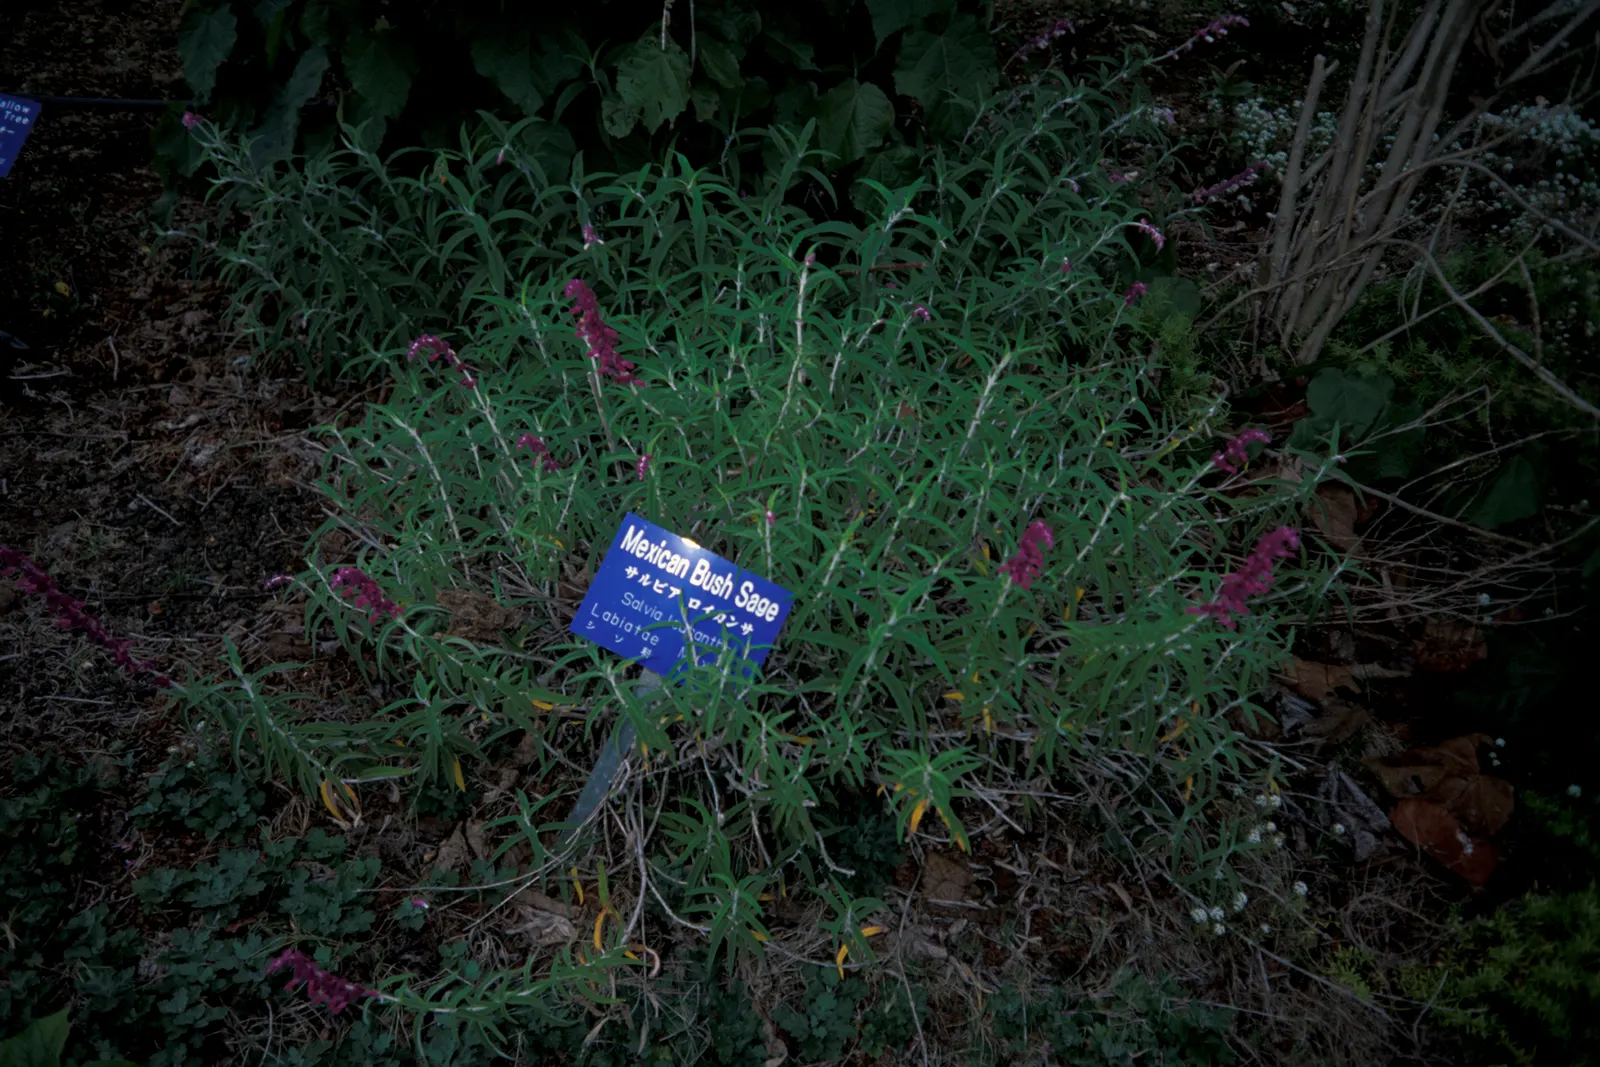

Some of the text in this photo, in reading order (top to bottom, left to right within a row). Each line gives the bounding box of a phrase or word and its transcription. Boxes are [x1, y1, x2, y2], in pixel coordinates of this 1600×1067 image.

[4, 109, 29, 124] Tree
[620, 525, 779, 622] Mexican Bush Sage
[625, 565, 681, 599] サルビア
[590, 602, 660, 645] Labiatae
[621, 592, 663, 621] Salvia
